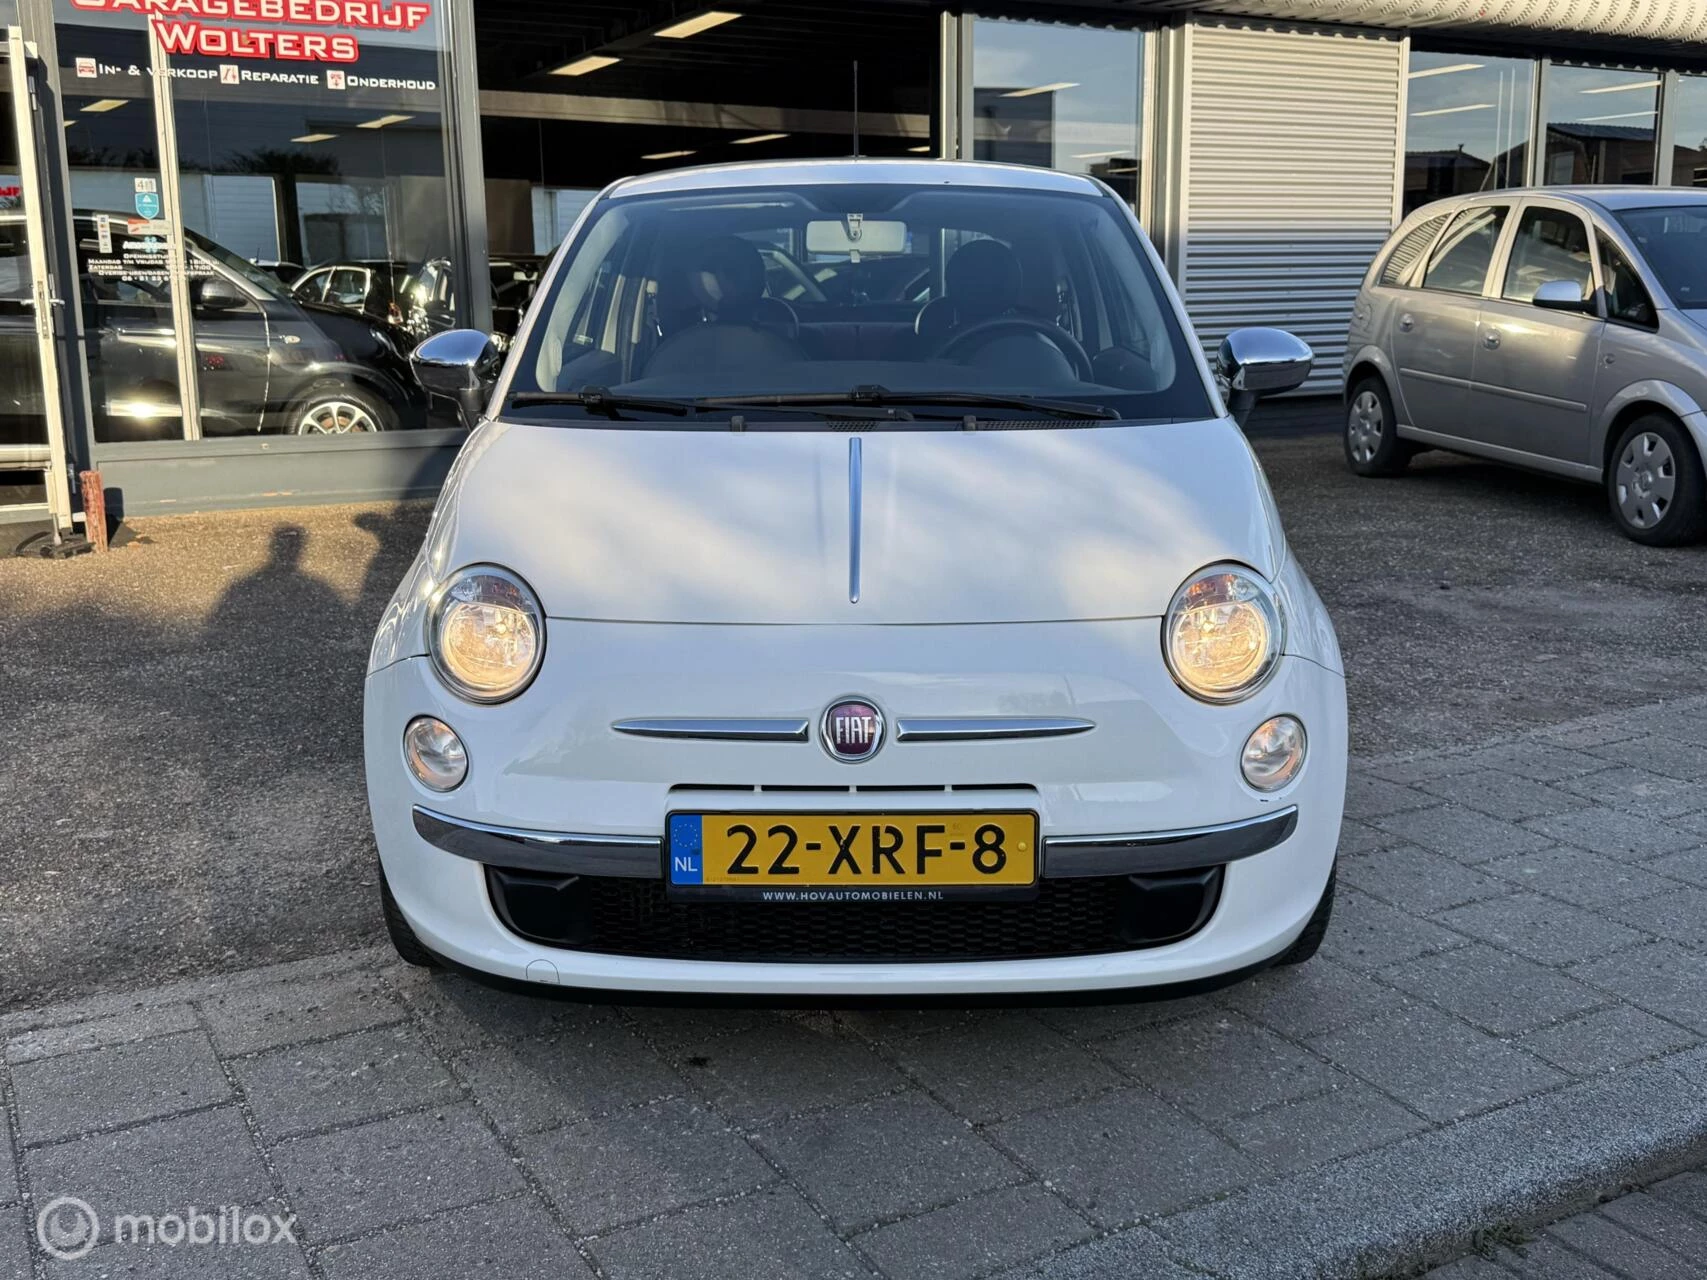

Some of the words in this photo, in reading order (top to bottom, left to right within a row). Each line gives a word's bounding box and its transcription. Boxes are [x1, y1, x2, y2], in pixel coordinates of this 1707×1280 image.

[73, 0, 428, 28] RAGEBEDRIJF
[155, 21, 358, 60] WOLTERS
[127, 65, 141, 76] &
[240, 70, 319, 85] REPARATIE
[346, 75, 436, 90] ONDERHOUD
[835, 716, 872, 744] FIAT
[726, 824, 1007, 875] 22-XRF-8
[674, 856, 698, 873] NL
[762, 890, 944, 901] WWW.HOVAUTOMOBIELEN.NL
